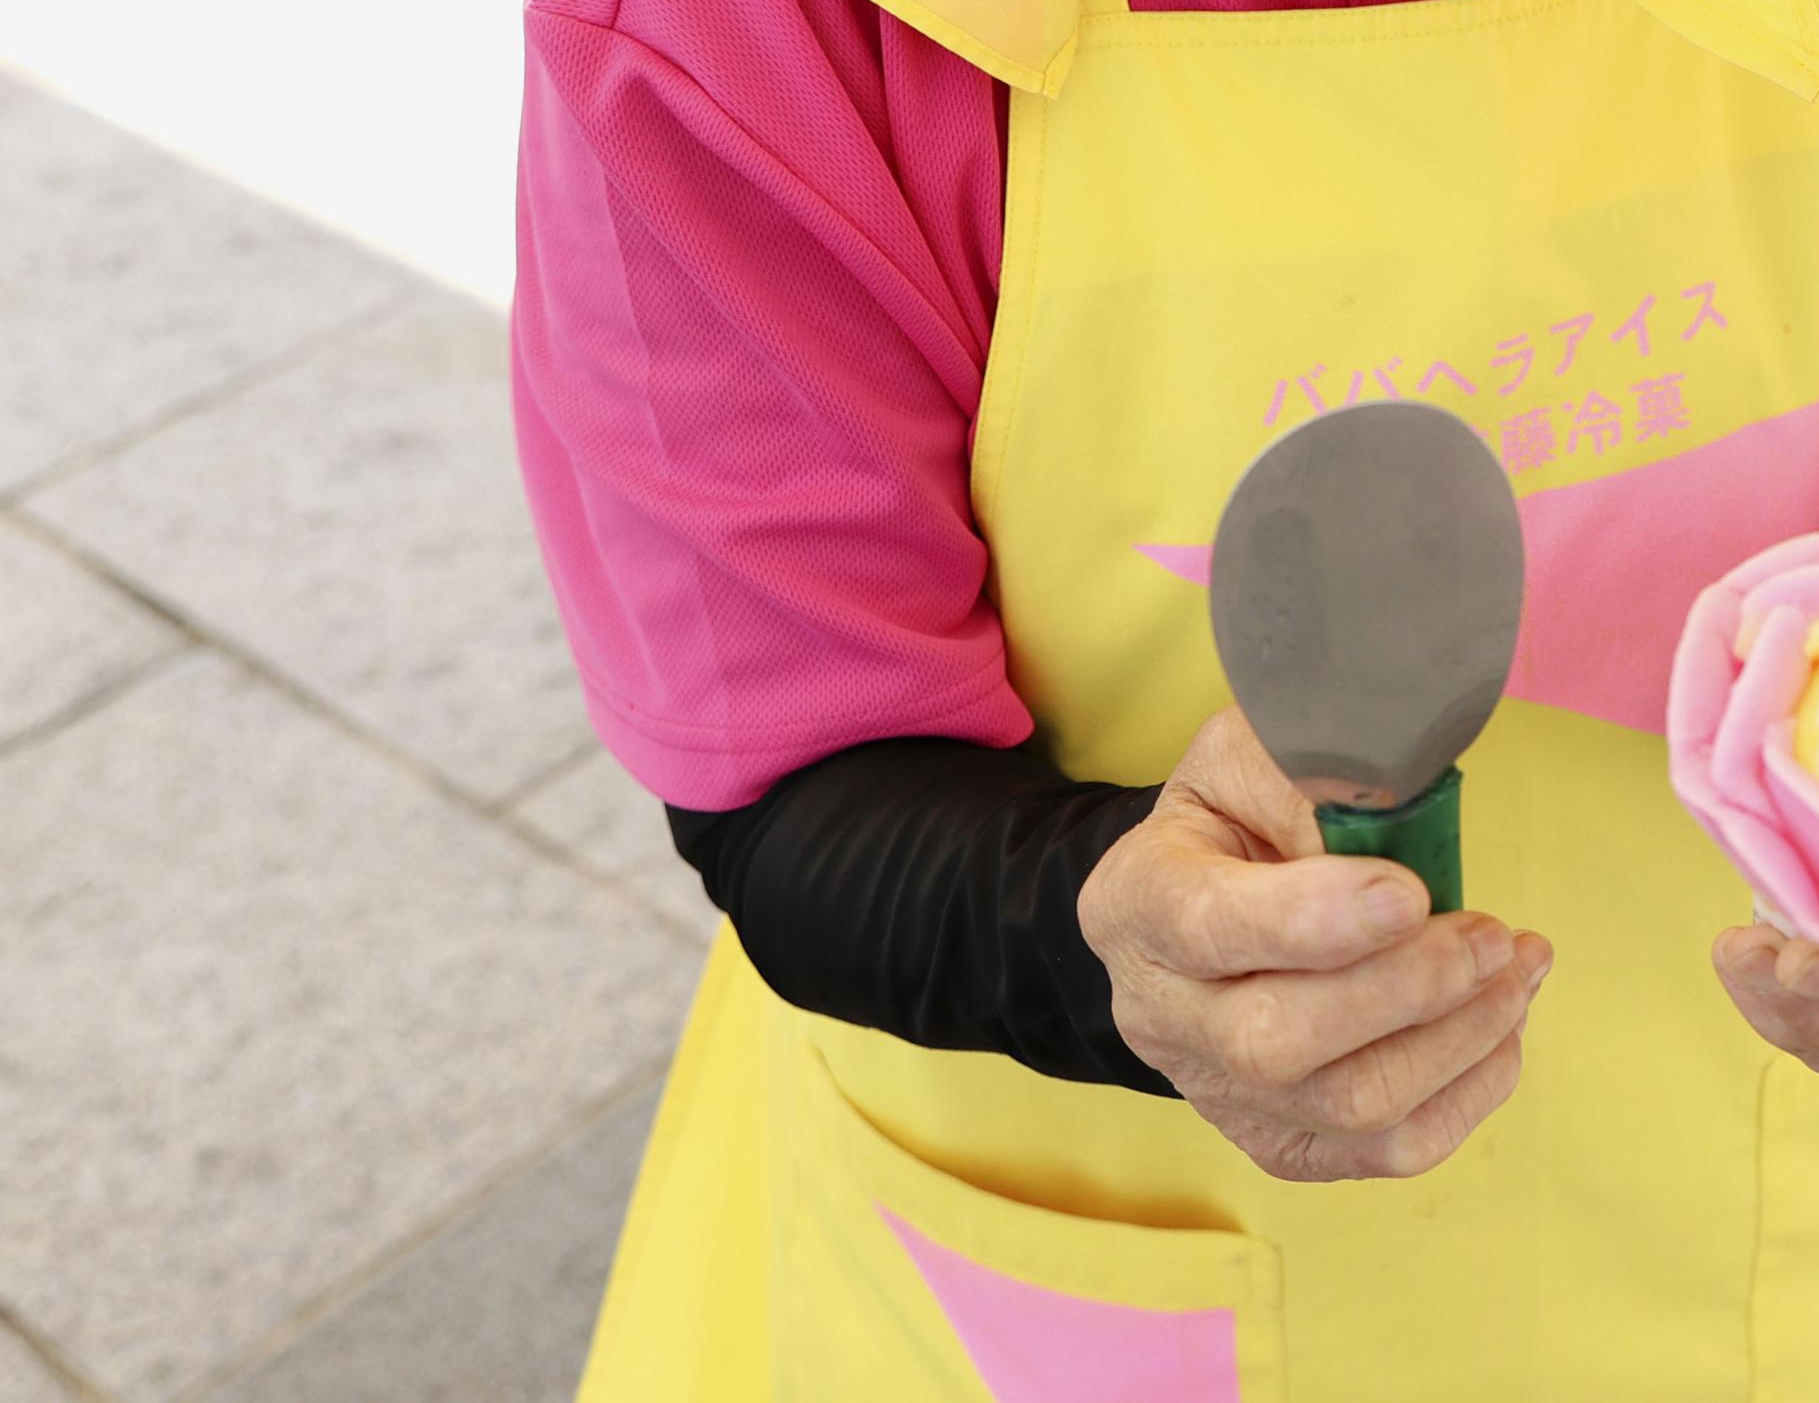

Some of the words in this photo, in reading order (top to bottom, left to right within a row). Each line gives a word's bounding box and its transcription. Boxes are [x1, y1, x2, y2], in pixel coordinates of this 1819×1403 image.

[1263, 281, 1728, 427] ババヘラアイス
[1470, 372, 1691, 475] 藤冷菓
